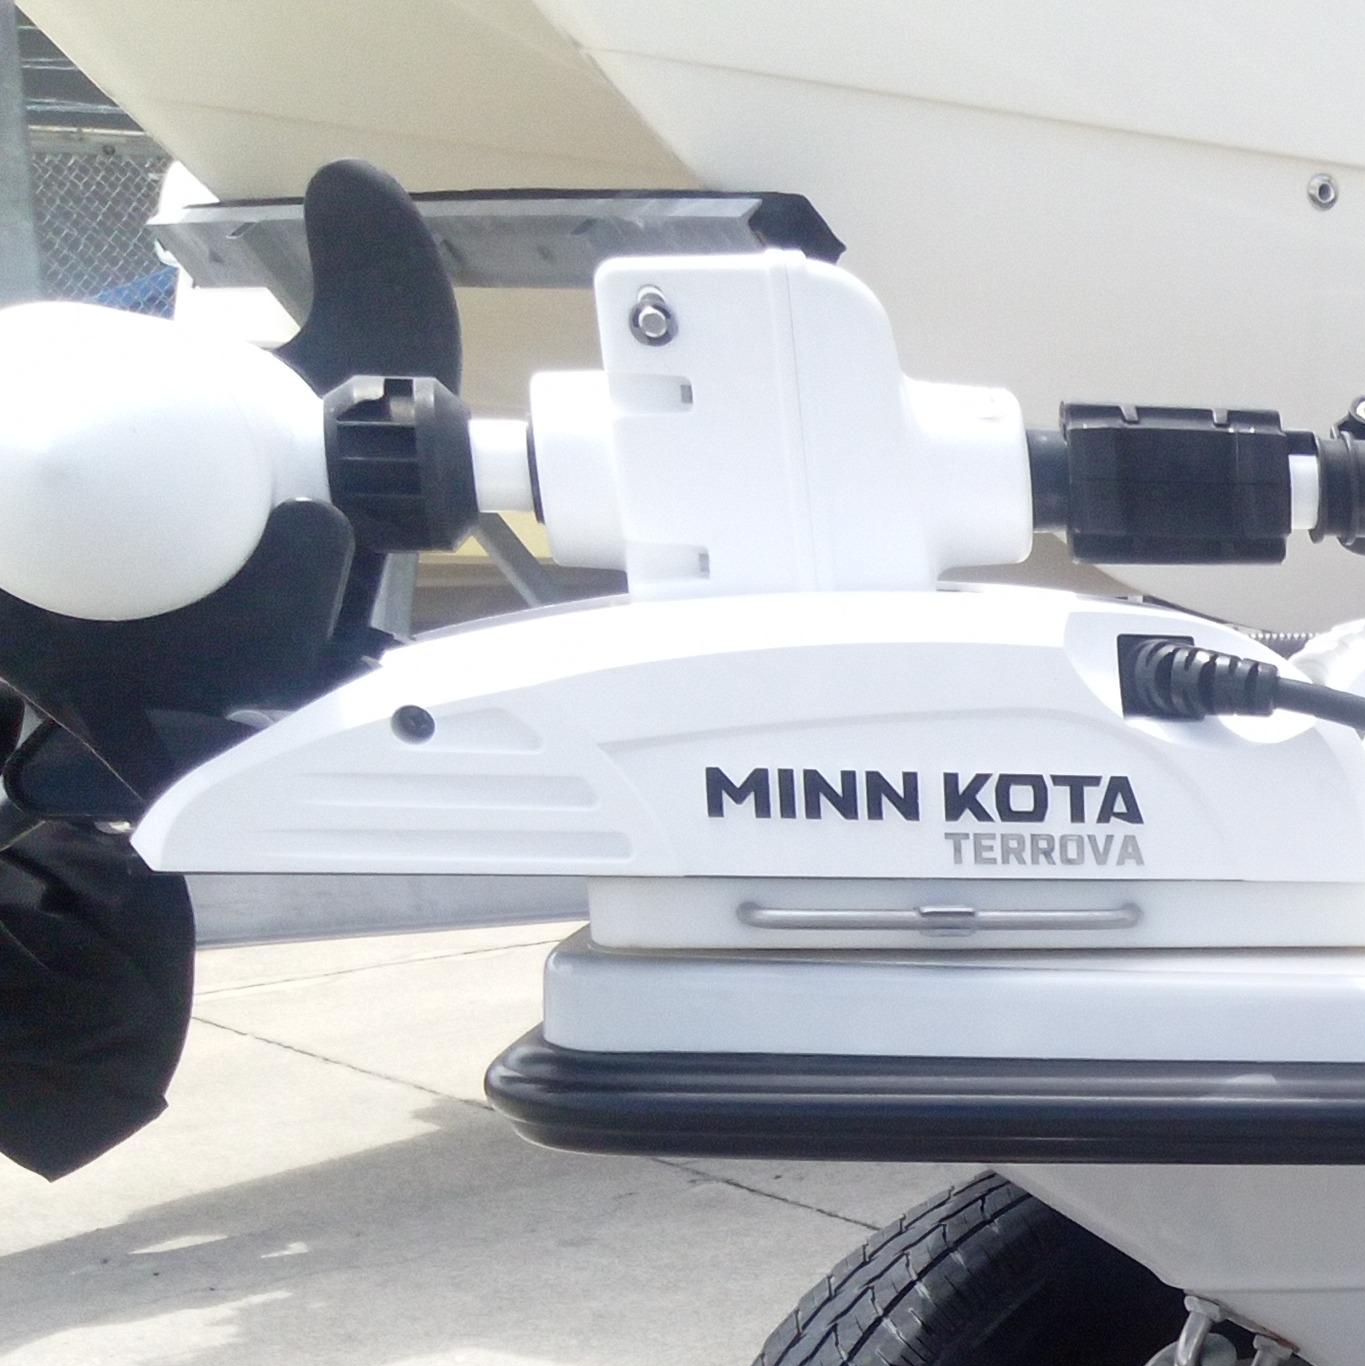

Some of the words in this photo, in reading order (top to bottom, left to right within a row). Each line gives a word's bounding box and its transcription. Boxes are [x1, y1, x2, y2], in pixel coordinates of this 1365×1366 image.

[704, 766, 920, 821] MINN
[944, 772, 1145, 824] KOTA
[944, 831, 1145, 867] TERROVA
